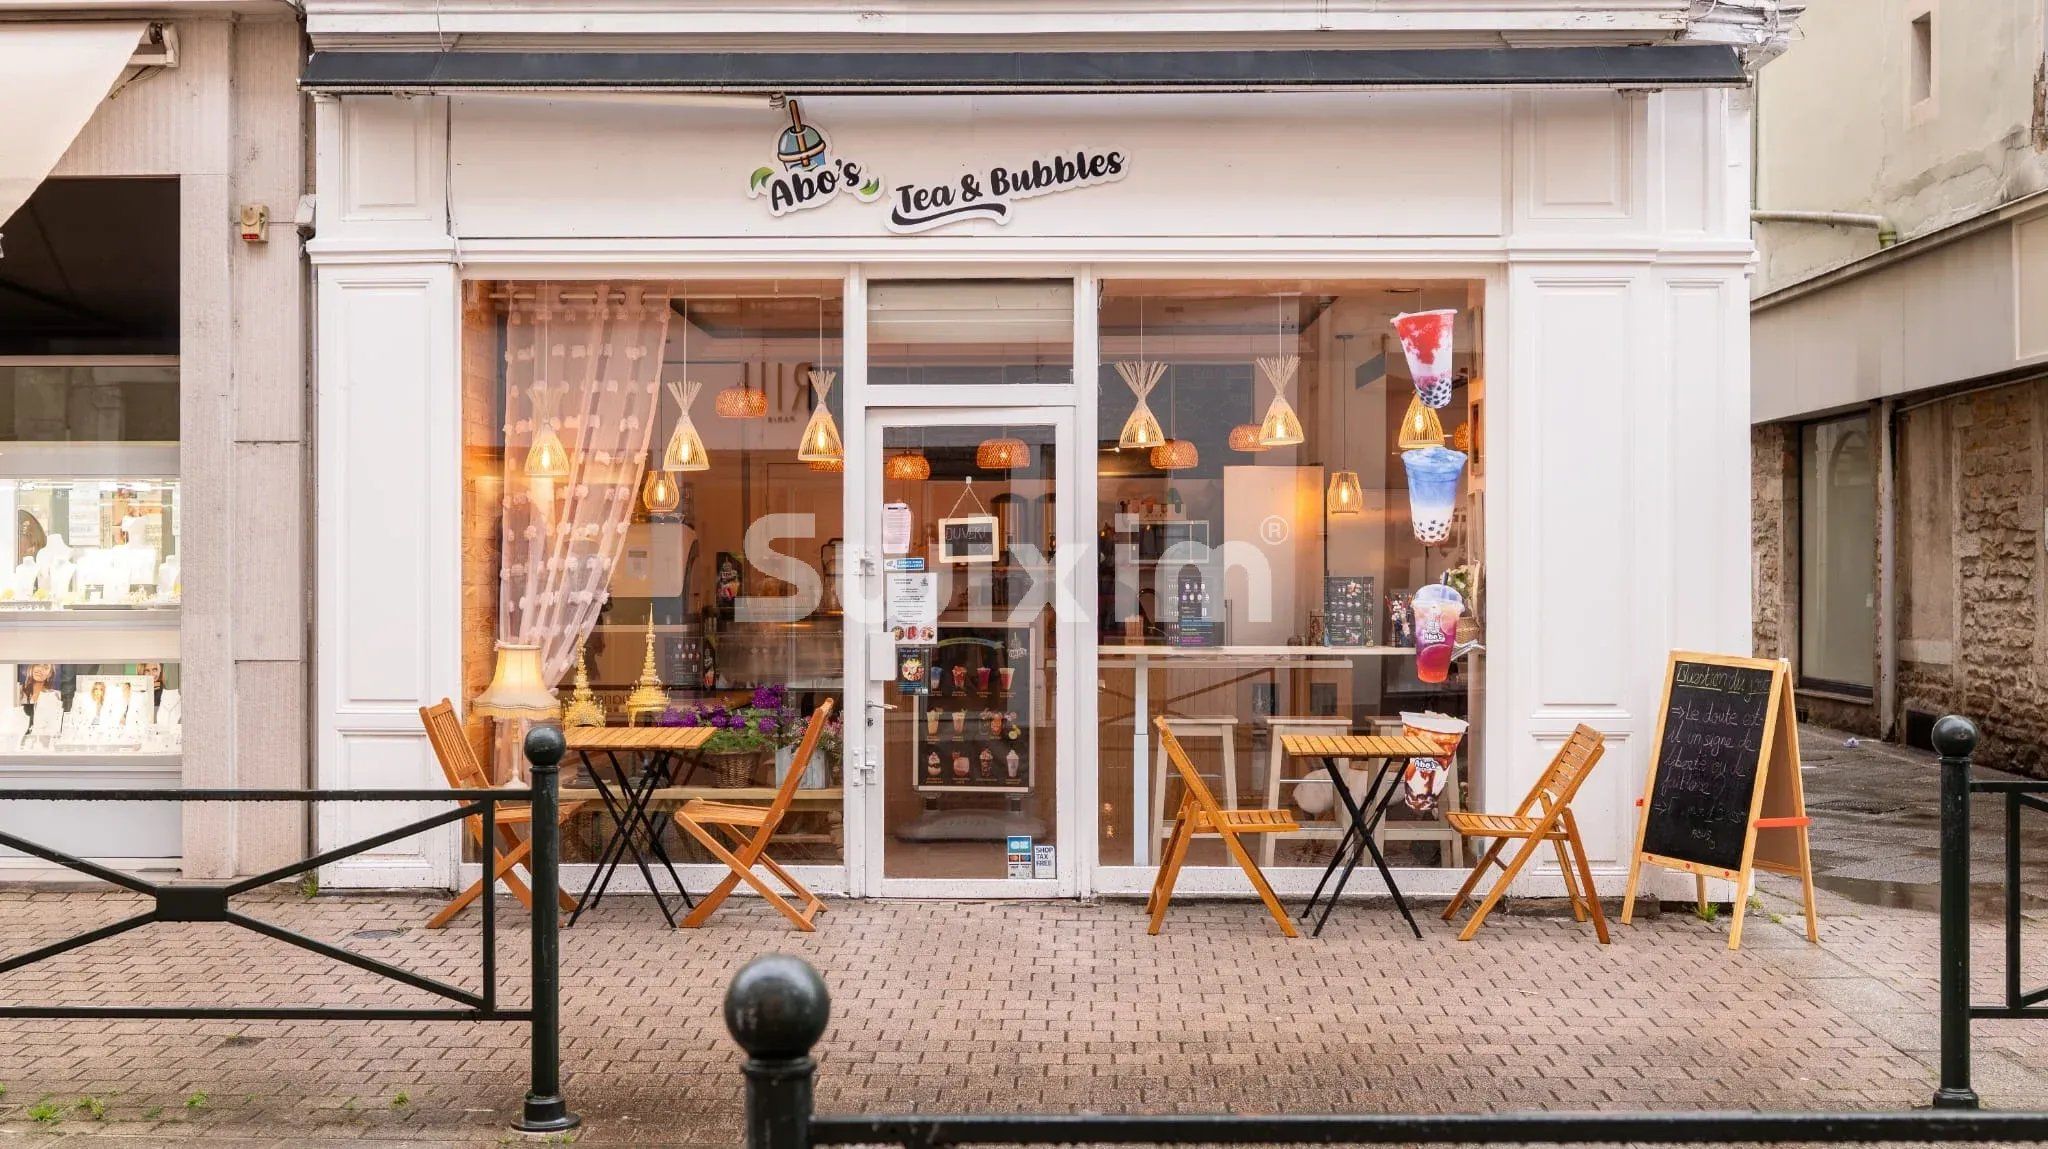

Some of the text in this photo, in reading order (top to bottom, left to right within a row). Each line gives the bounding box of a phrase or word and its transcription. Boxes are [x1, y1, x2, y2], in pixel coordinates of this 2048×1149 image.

[771, 148, 1125, 214] Abo's Tea & Bubbles
[1677, 664, 1727, 688] Question
[1703, 701, 1739, 726] doute
[1687, 733, 1702, 746] un
[1703, 735, 1735, 757] signe
[1035, 846, 1054, 854] SHOP
